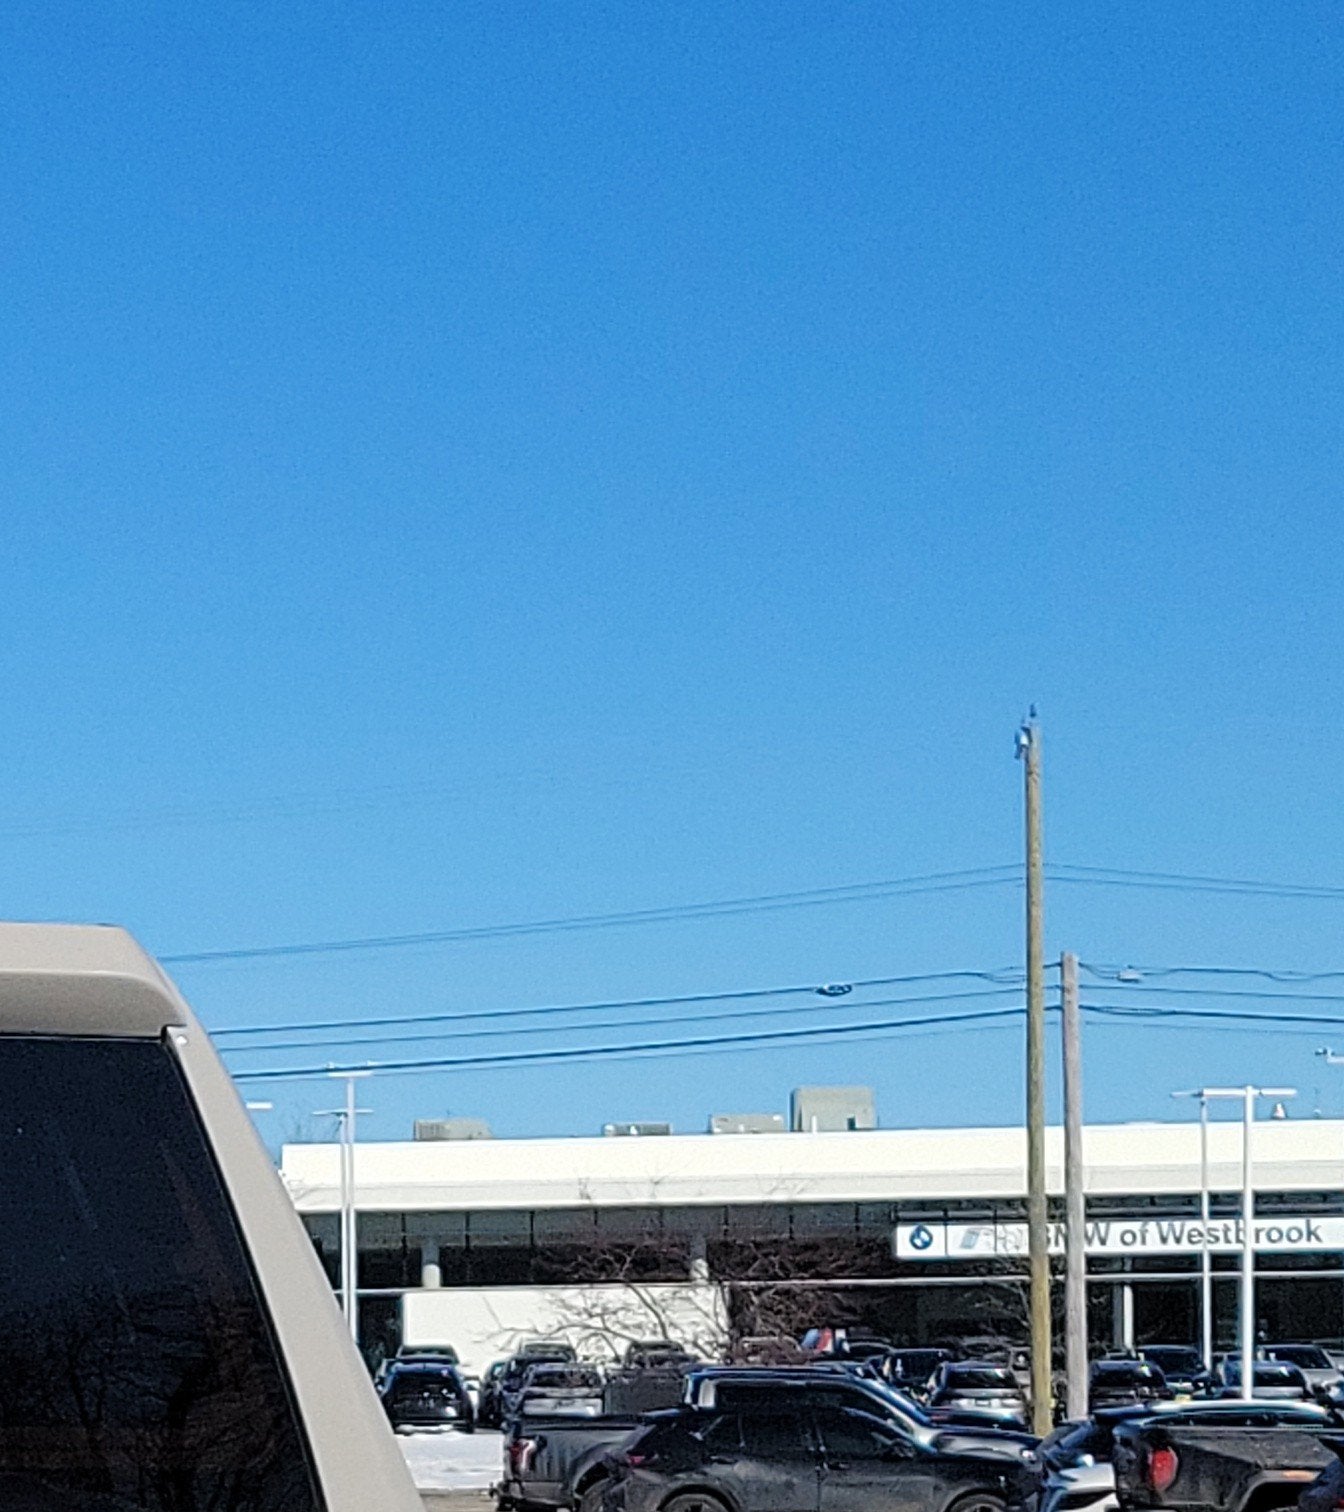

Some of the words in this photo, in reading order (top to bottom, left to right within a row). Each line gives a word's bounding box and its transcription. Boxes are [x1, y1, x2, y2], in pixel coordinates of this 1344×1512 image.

[1045, 1222, 1111, 1247] MW
[1119, 1221, 1148, 1246] of
[1157, 1218, 1323, 1246] Westbrook
